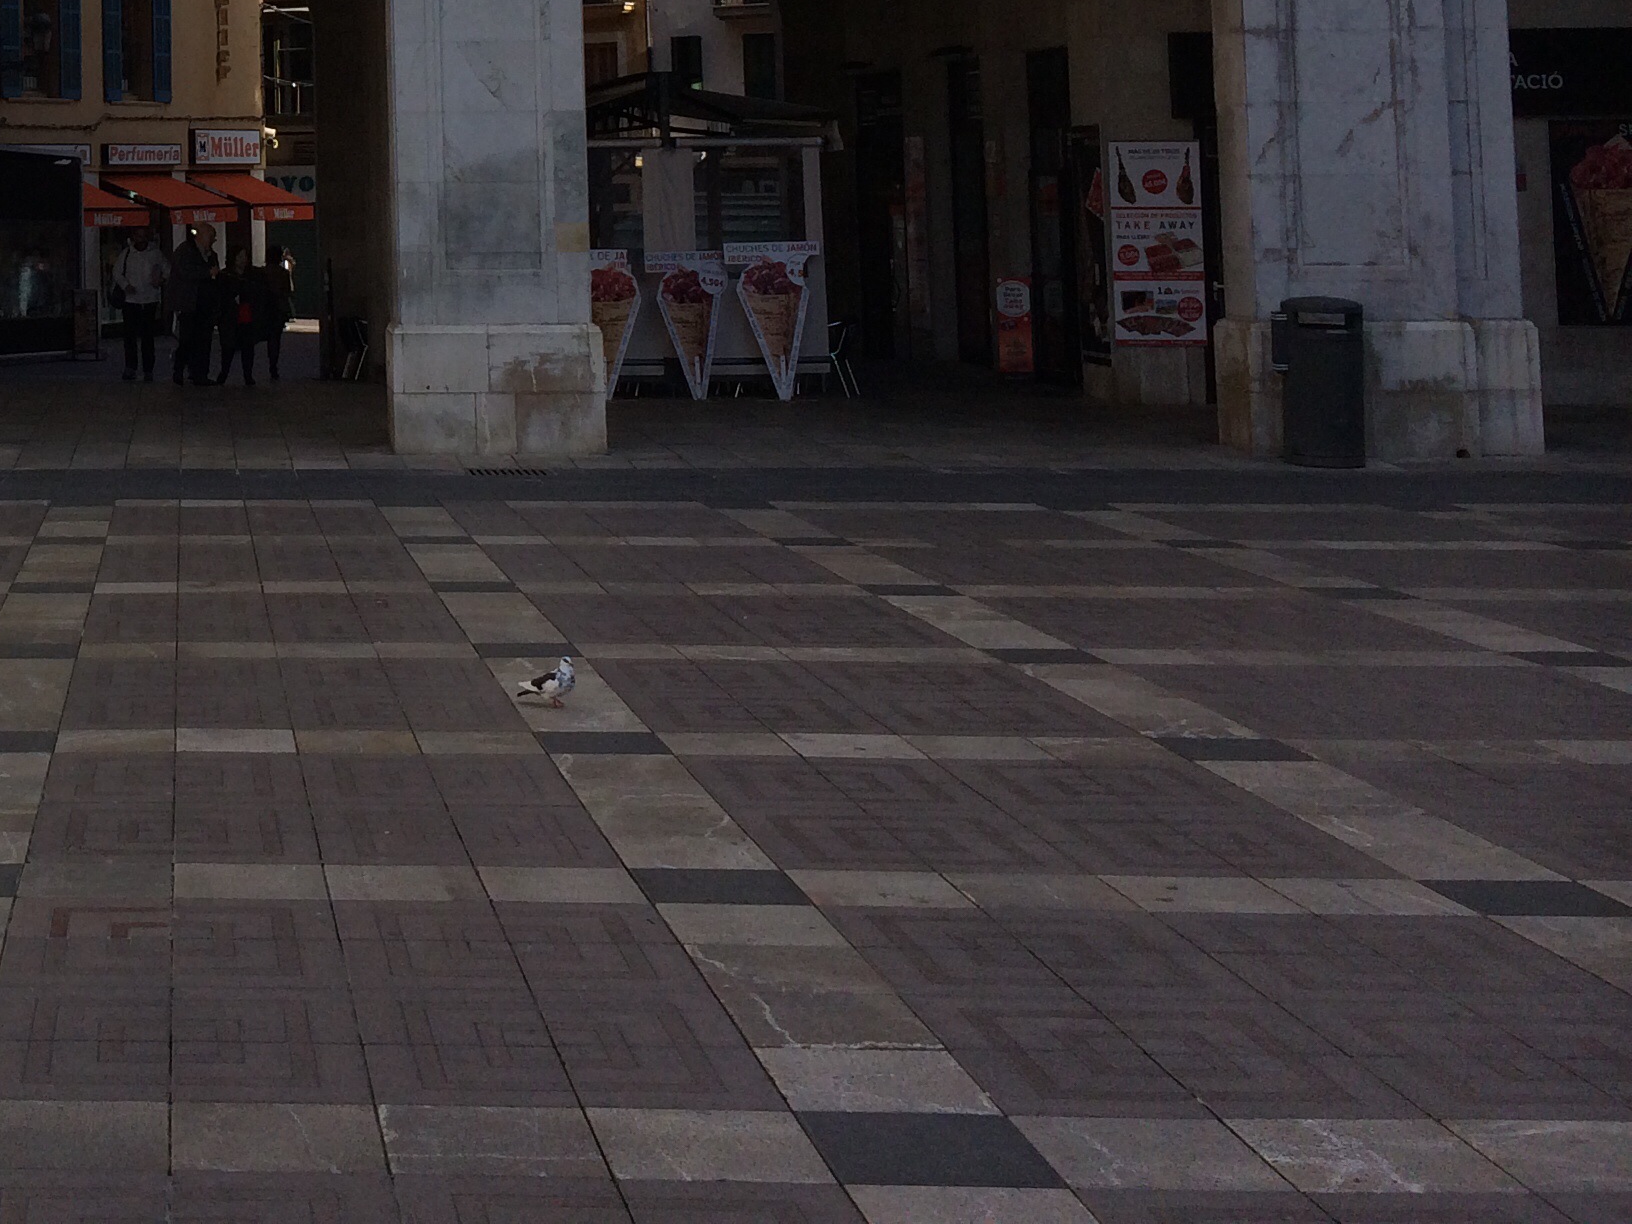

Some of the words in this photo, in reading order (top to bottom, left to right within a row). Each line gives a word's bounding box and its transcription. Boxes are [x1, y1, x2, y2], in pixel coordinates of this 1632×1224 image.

[210, 136, 260, 158] Müller
[109, 144, 180, 163] Perfumería
[1116, 220, 1151, 230] TAKE
[1159, 220, 1195, 230] AWAY
[726, 243, 770, 253] CHUCHES
[771, 243, 785, 253] DE
[786, 241, 817, 252] JAMÓN
[597, 251, 611, 260] DE
[645, 253, 684, 262] CHUCHES
[686, 252, 696, 261] DE
